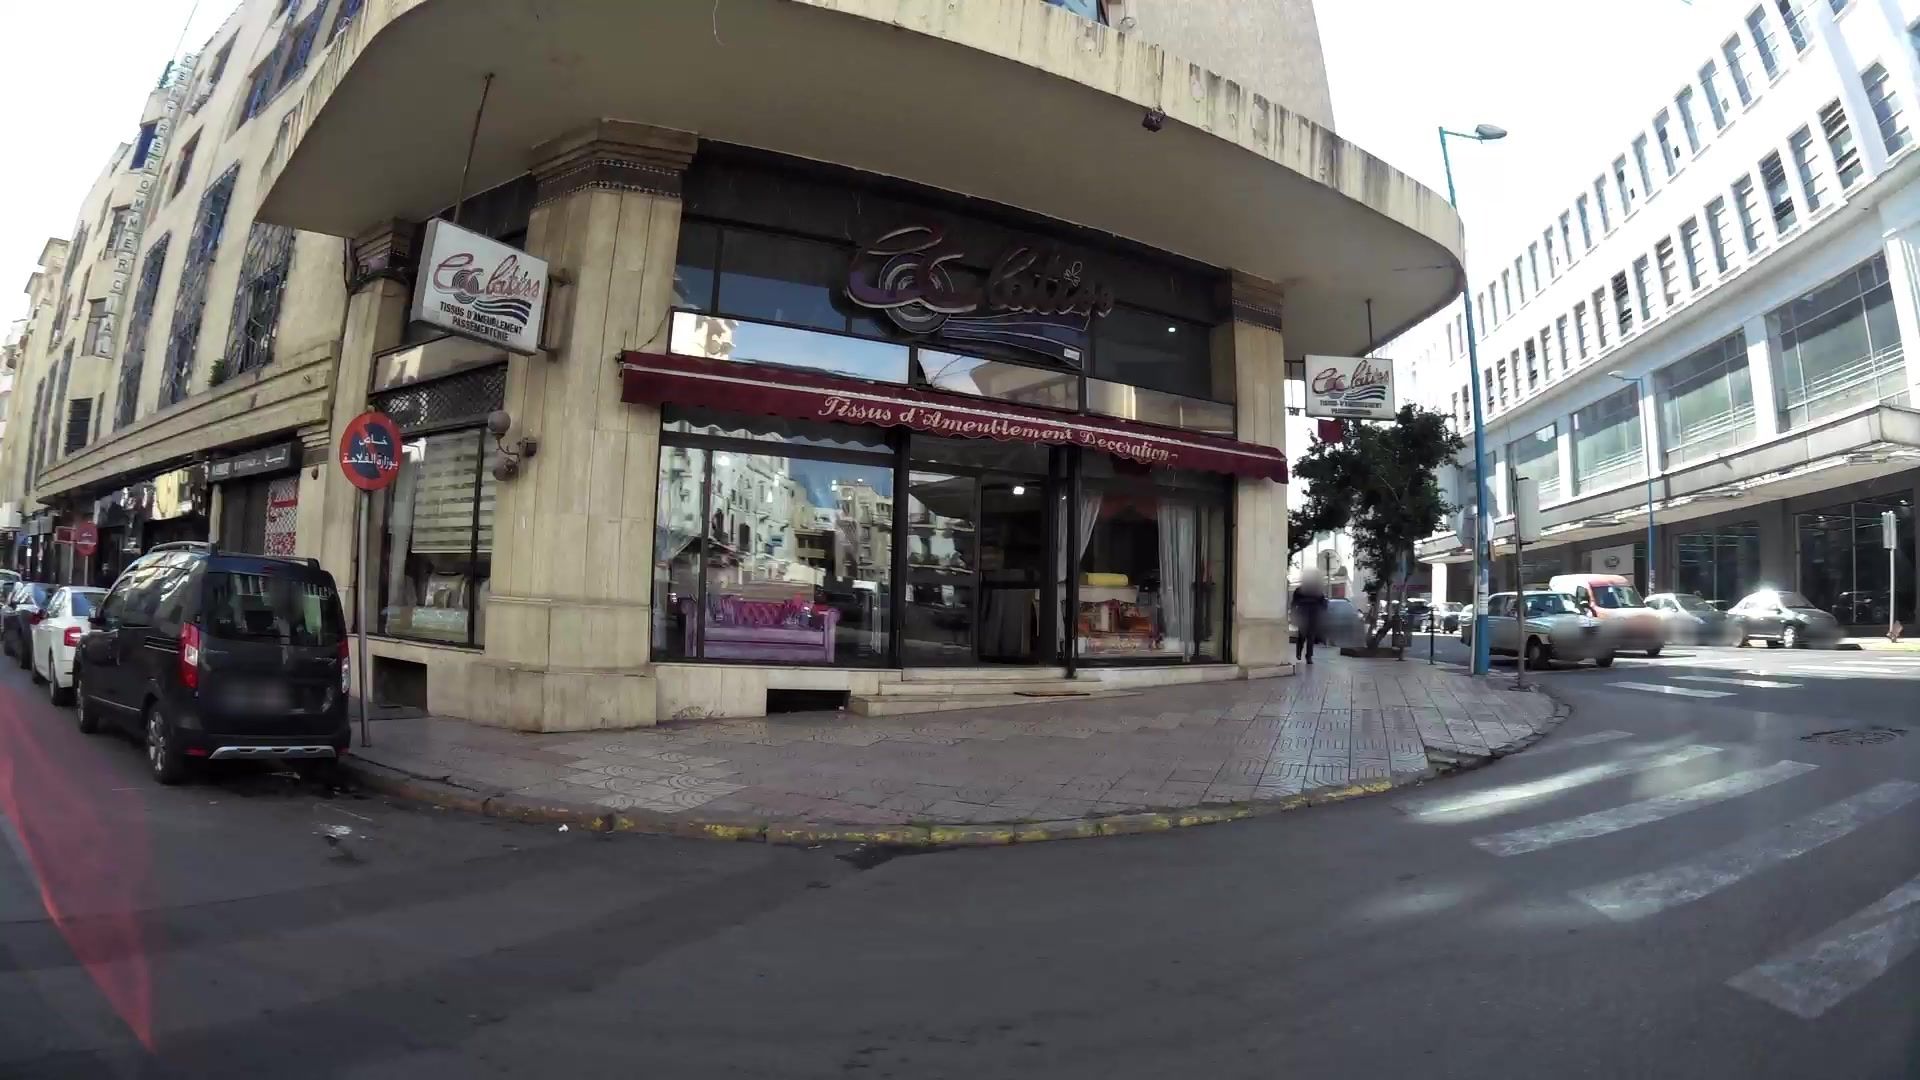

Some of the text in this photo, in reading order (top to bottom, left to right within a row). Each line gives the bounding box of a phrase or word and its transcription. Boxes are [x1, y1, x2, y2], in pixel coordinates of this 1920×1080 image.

[100, 160, 155, 354] COMMERCIAL
[440, 300, 523, 336] TISSUS D'AMEUBLEMENT
[452, 315, 509, 341] PASSEMENTERIE
[818, 396, 892, 421] Tissus
[899, 407, 1073, 441] d'Ameublement
[358, 433, 388, 447] خاص
[342, 452, 376, 464] الفلاحة
